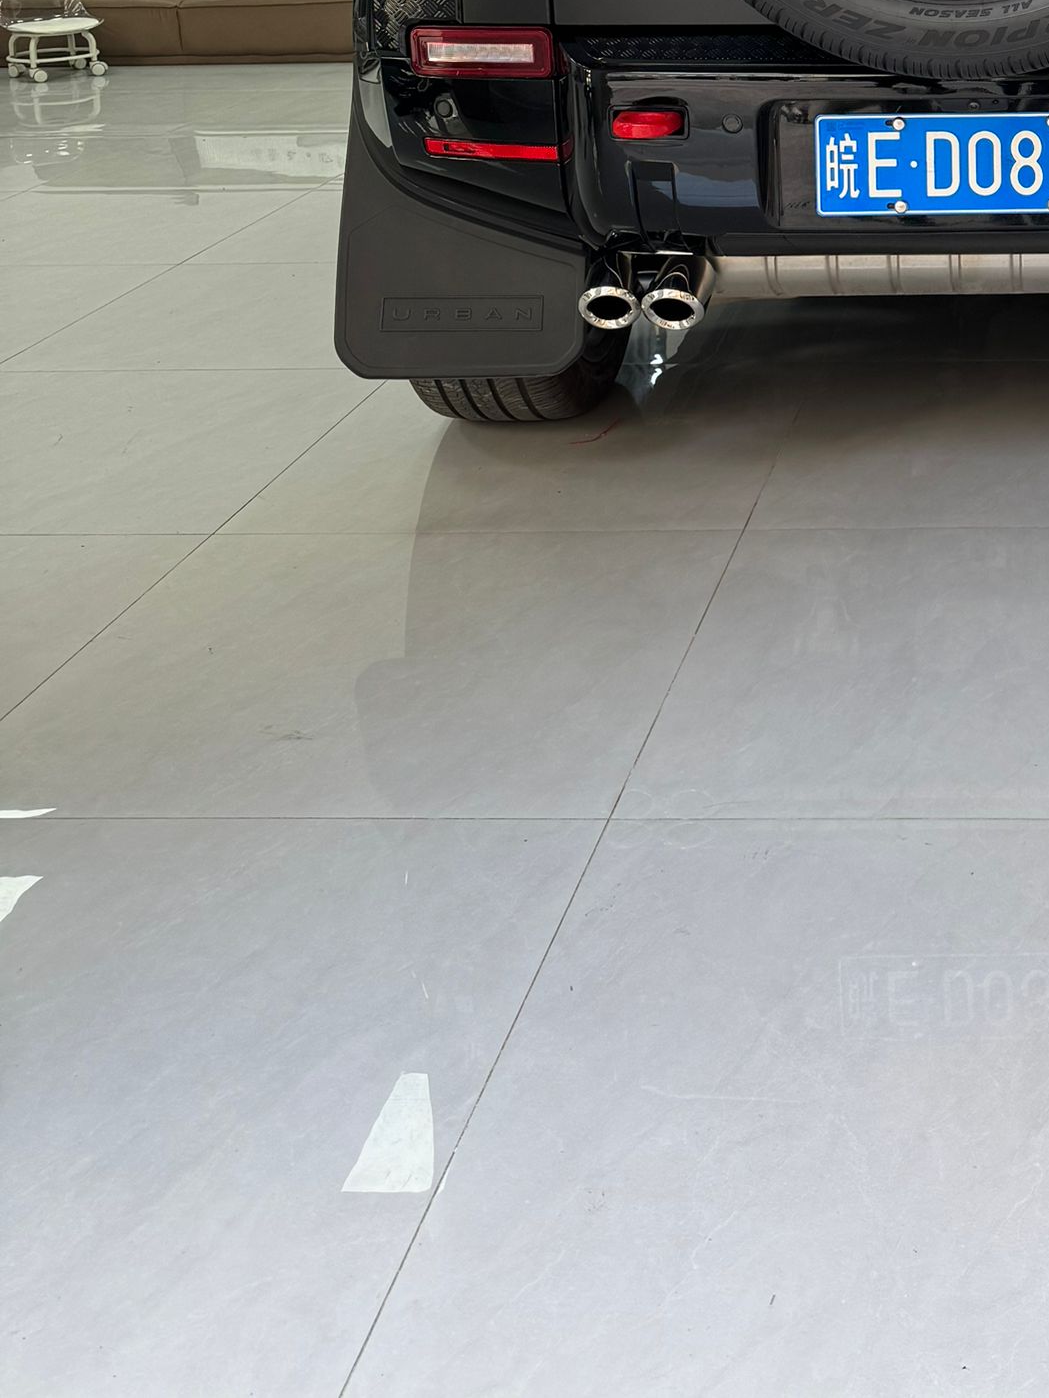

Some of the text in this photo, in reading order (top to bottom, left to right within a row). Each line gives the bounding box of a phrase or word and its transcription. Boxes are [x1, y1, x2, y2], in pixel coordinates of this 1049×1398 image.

[909, 0, 1033, 18] ALL SEASON
[392, 307, 533, 321] URBAN
